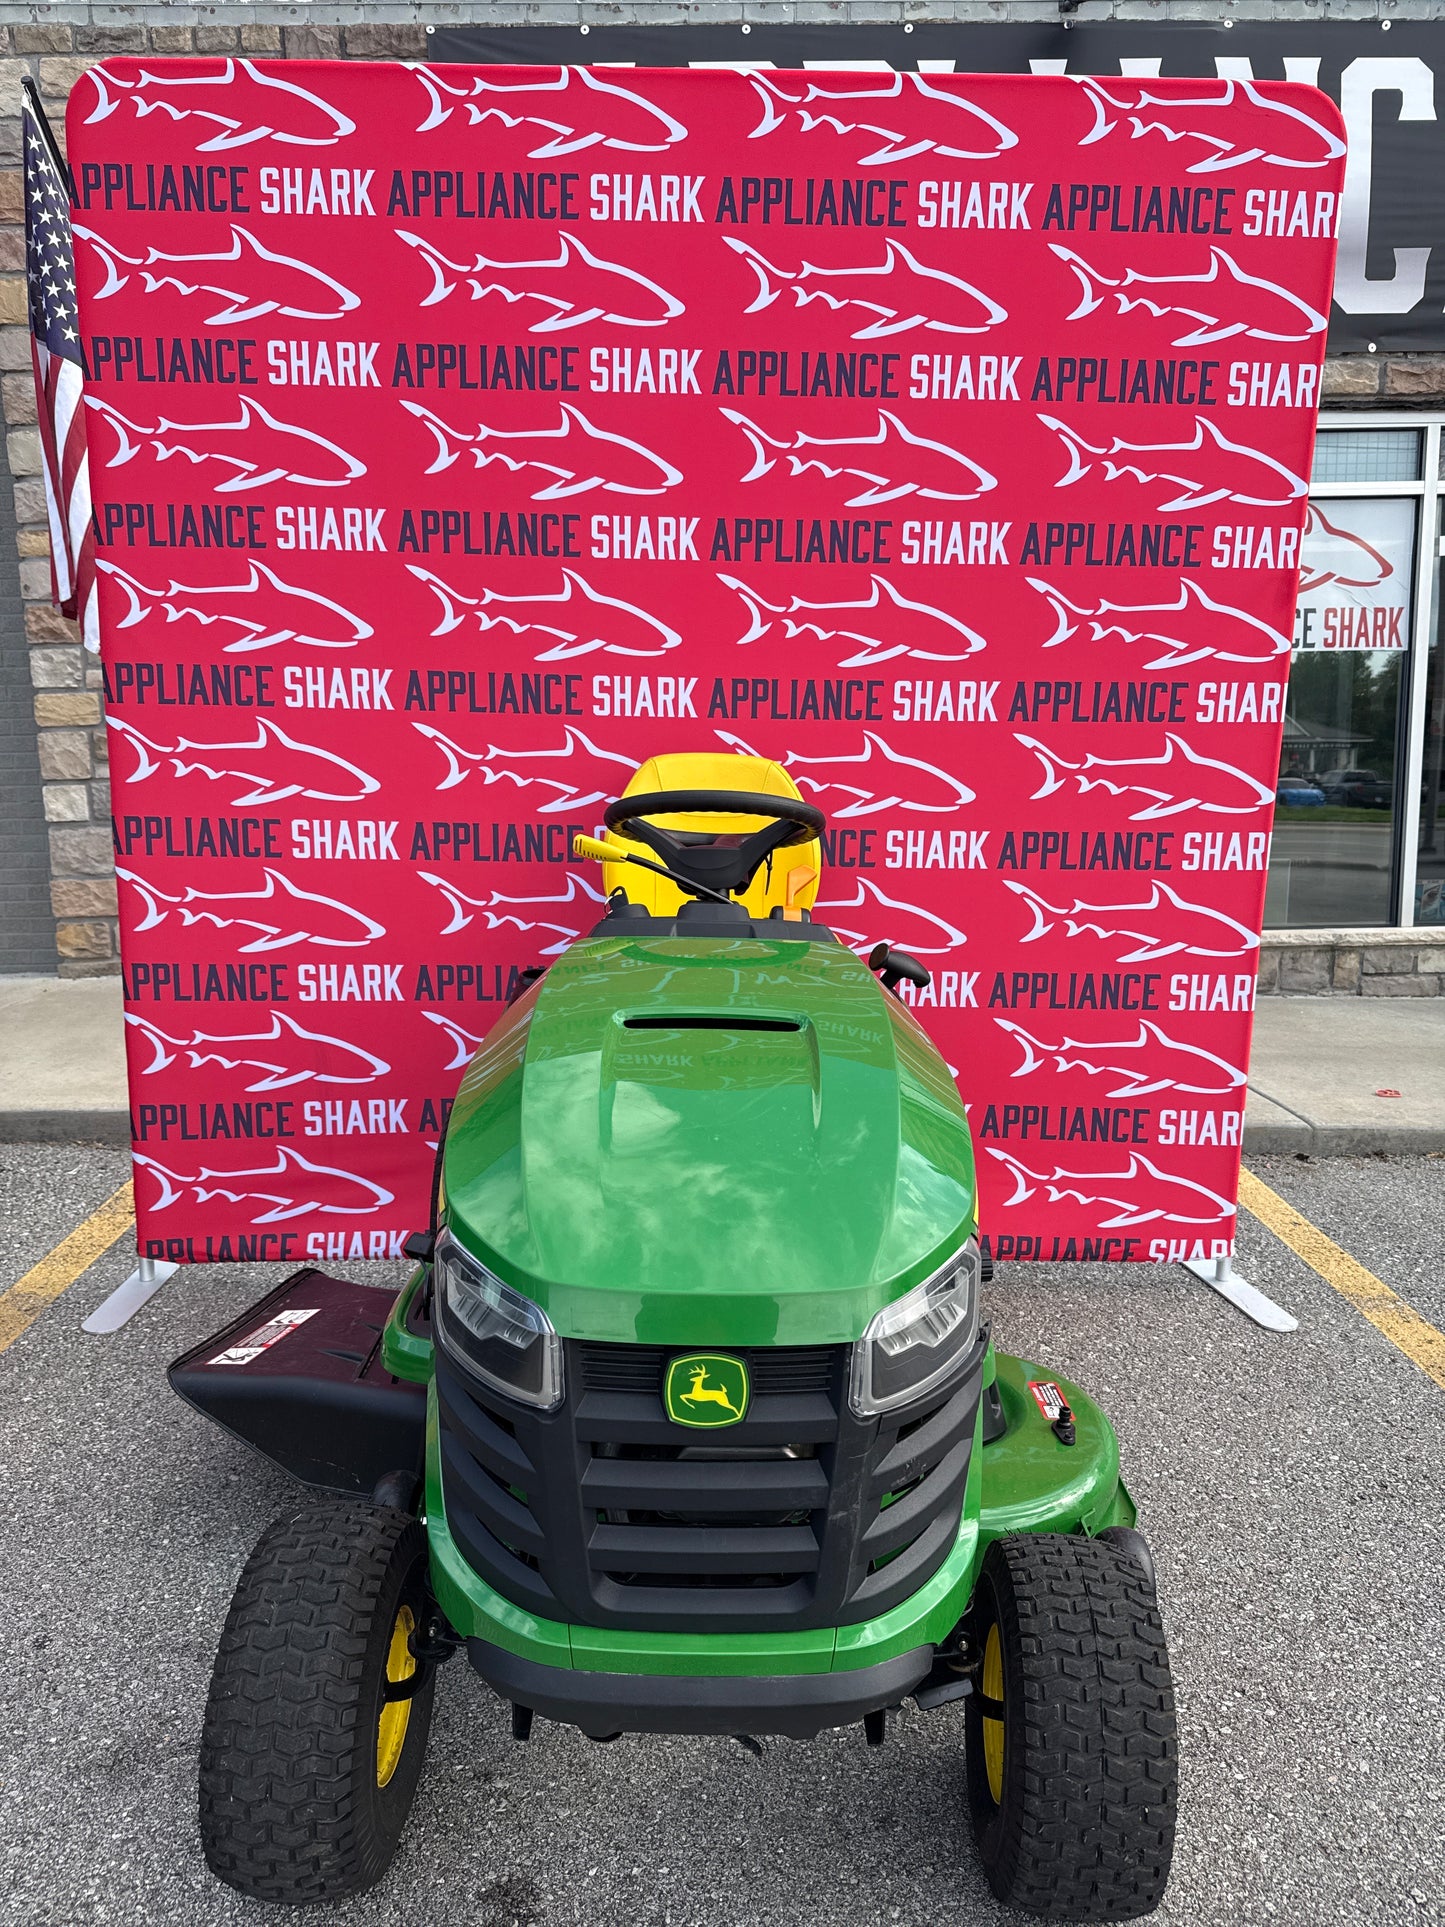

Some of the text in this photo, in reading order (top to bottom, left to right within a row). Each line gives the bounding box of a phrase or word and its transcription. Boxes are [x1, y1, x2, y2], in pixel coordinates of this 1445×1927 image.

[260, 166, 376, 216] SHARK
[387, 170, 579, 219] APPLIANCE
[590, 173, 705, 223] SHARK
[715, 177, 908, 226] APPLIANCE
[918, 180, 1034, 229] SHARK
[1042, 184, 1235, 234] APPLIANCE
[1243, 189, 1342, 239] SHAR
[268, 340, 381, 387] SHARK
[392, 343, 579, 391] APPLIANCE
[590, 347, 702, 395] SHARK
[712, 350, 900, 398] APPLIANCE
[910, 354, 1023, 401] SHARK
[1031, 357, 1219, 405] APPLIANCE
[1228, 361, 1325, 408] SHAR
[276, 506, 387, 552] SHARK
[398, 509, 580, 557] APPLIANCE
[591, 514, 700, 561] SHARK
[710, 518, 892, 563] APPLIANCE
[902, 520, 1012, 565] SHARK
[1020, 523, 1204, 567] APPLIANCE
[1212, 525, 1304, 569] SHAR
[1323, 607, 1405, 648] SHARK
[284, 666, 394, 711] SHARK
[405, 670, 582, 715] APPLIANCE
[593, 675, 698, 718] SHARK
[708, 678, 884, 720] APPLIANCE
[893, 680, 1000, 722] SHARK
[1008, 682, 1188, 722] APPLIANCE
[1196, 682, 1289, 724] SHAR
[292, 818, 400, 861] SHARK
[410, 822, 584, 863] APPLIANCE
[886, 829, 990, 870] SHARK
[998, 831, 1174, 870] APPLIANCE
[1182, 831, 1272, 871] SHAR
[298, 964, 404, 1002] SHARK
[880, 970, 981, 1008] HARK
[988, 973, 1161, 1010] APPLIANCE
[1169, 974, 1257, 1012] SHAR
[304, 1099, 408, 1136] SHARK
[980, 1105, 1243, 1147] APPLIANCE SHAR
[306, 1230, 409, 1260] SHARK
